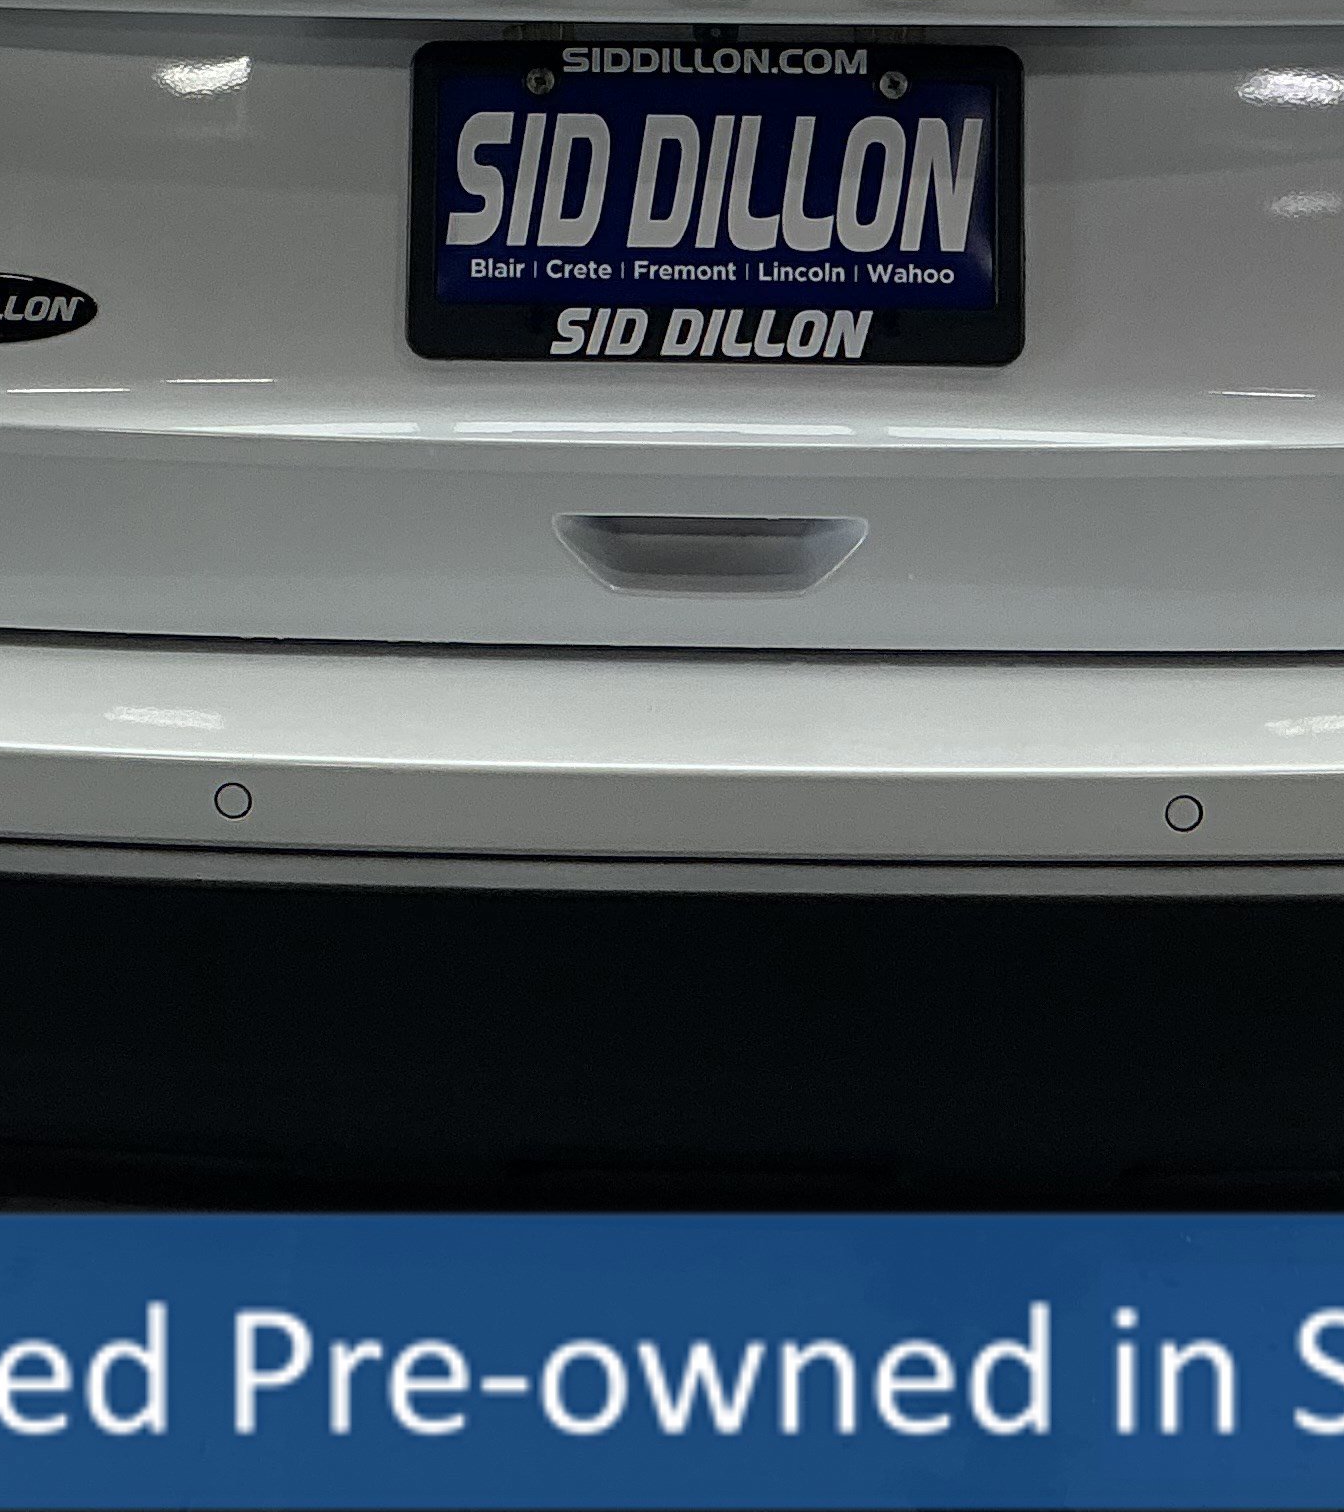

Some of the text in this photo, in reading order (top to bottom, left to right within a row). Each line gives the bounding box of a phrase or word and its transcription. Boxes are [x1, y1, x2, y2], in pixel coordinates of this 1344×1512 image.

[562, 46, 868, 76] SIDDILLON.COM
[446, 111, 984, 253] SID DILLON
[470, 258, 955, 286] Blair Crete Fremont Lincoln Wahoo
[549, 307, 874, 359] SID DILLON
